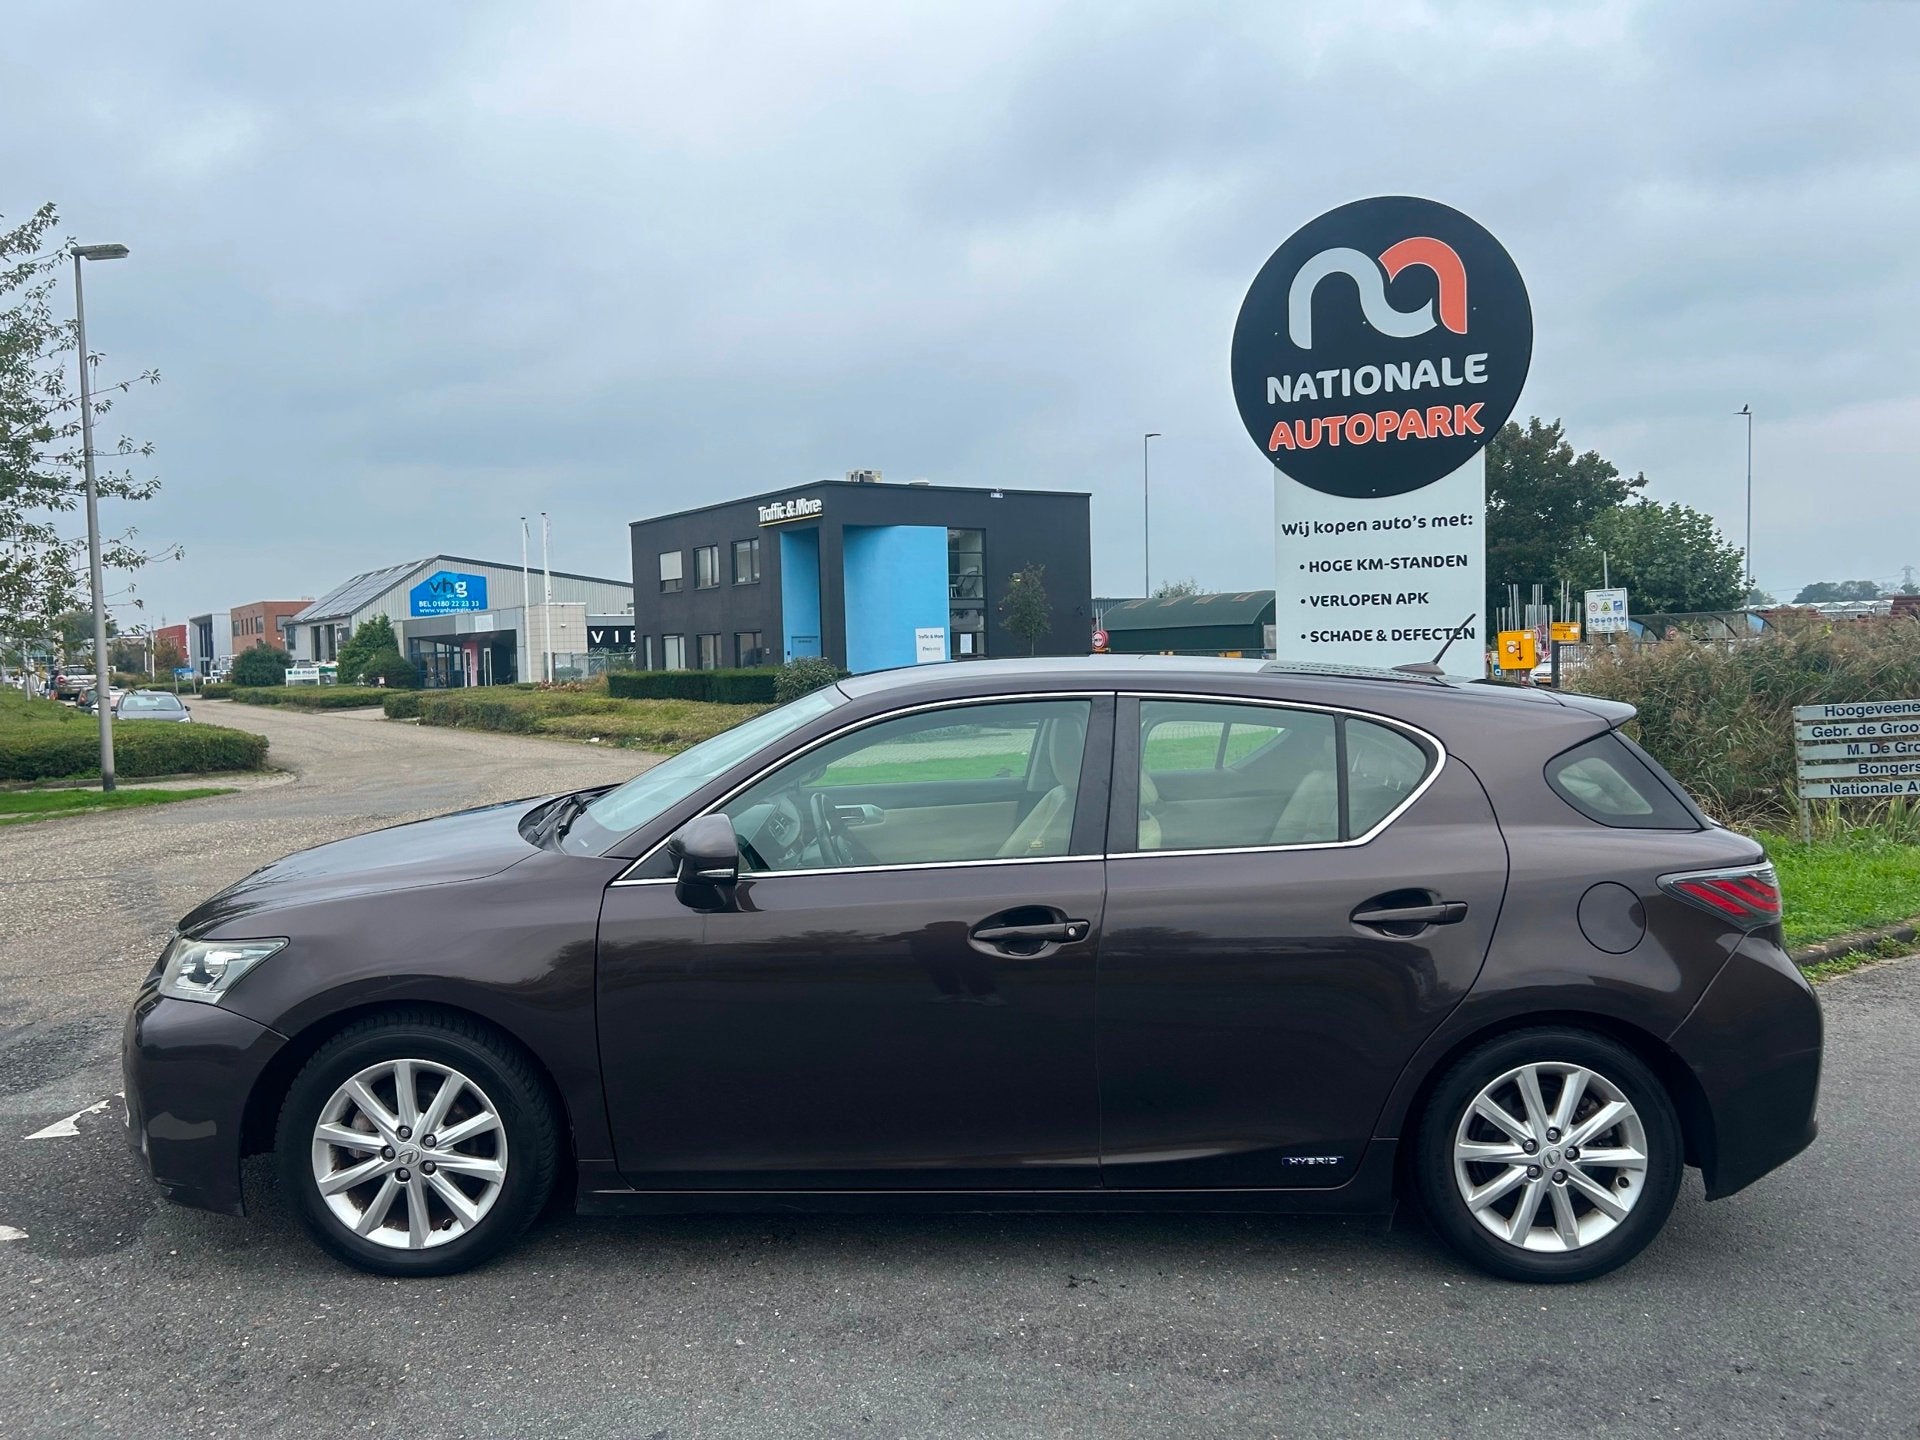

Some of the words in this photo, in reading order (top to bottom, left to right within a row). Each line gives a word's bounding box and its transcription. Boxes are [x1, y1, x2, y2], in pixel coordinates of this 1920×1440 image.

[1266, 352, 1489, 405] NATIONALE
[1268, 402, 1486, 452] AUTOPARK
[757, 502, 786, 523] Traffic
[786, 500, 796, 518] &
[796, 498, 823, 515] More
[1281, 521, 1310, 538] Wij
[1313, 519, 1367, 535] kopen
[1431, 513, 1474, 528] met:
[1308, 559, 1353, 573] HOGE
[1356, 554, 1468, 571] KM-STANDEN
[429, 577, 468, 598] vhg
[418, 600, 431, 608] BEL
[1309, 593, 1392, 607] VERLOPEN
[1396, 592, 1430, 605] APK
[1309, 629, 1373, 643] SCHADE
[1376, 629, 1388, 642] &
[1391, 627, 1476, 642] DEFECTEN
[1811, 726, 1852, 738] Gebr.
[1857, 724, 1876, 736] de
[1880, 722, 1920, 734] Groo
[1847, 743, 1865, 756] M.
[1869, 743, 1890, 754] De
[1829, 782, 1903, 795] Nationale
[1907, 781, 1920, 793] A
[1289, 1156, 1338, 1165] HYBRID
